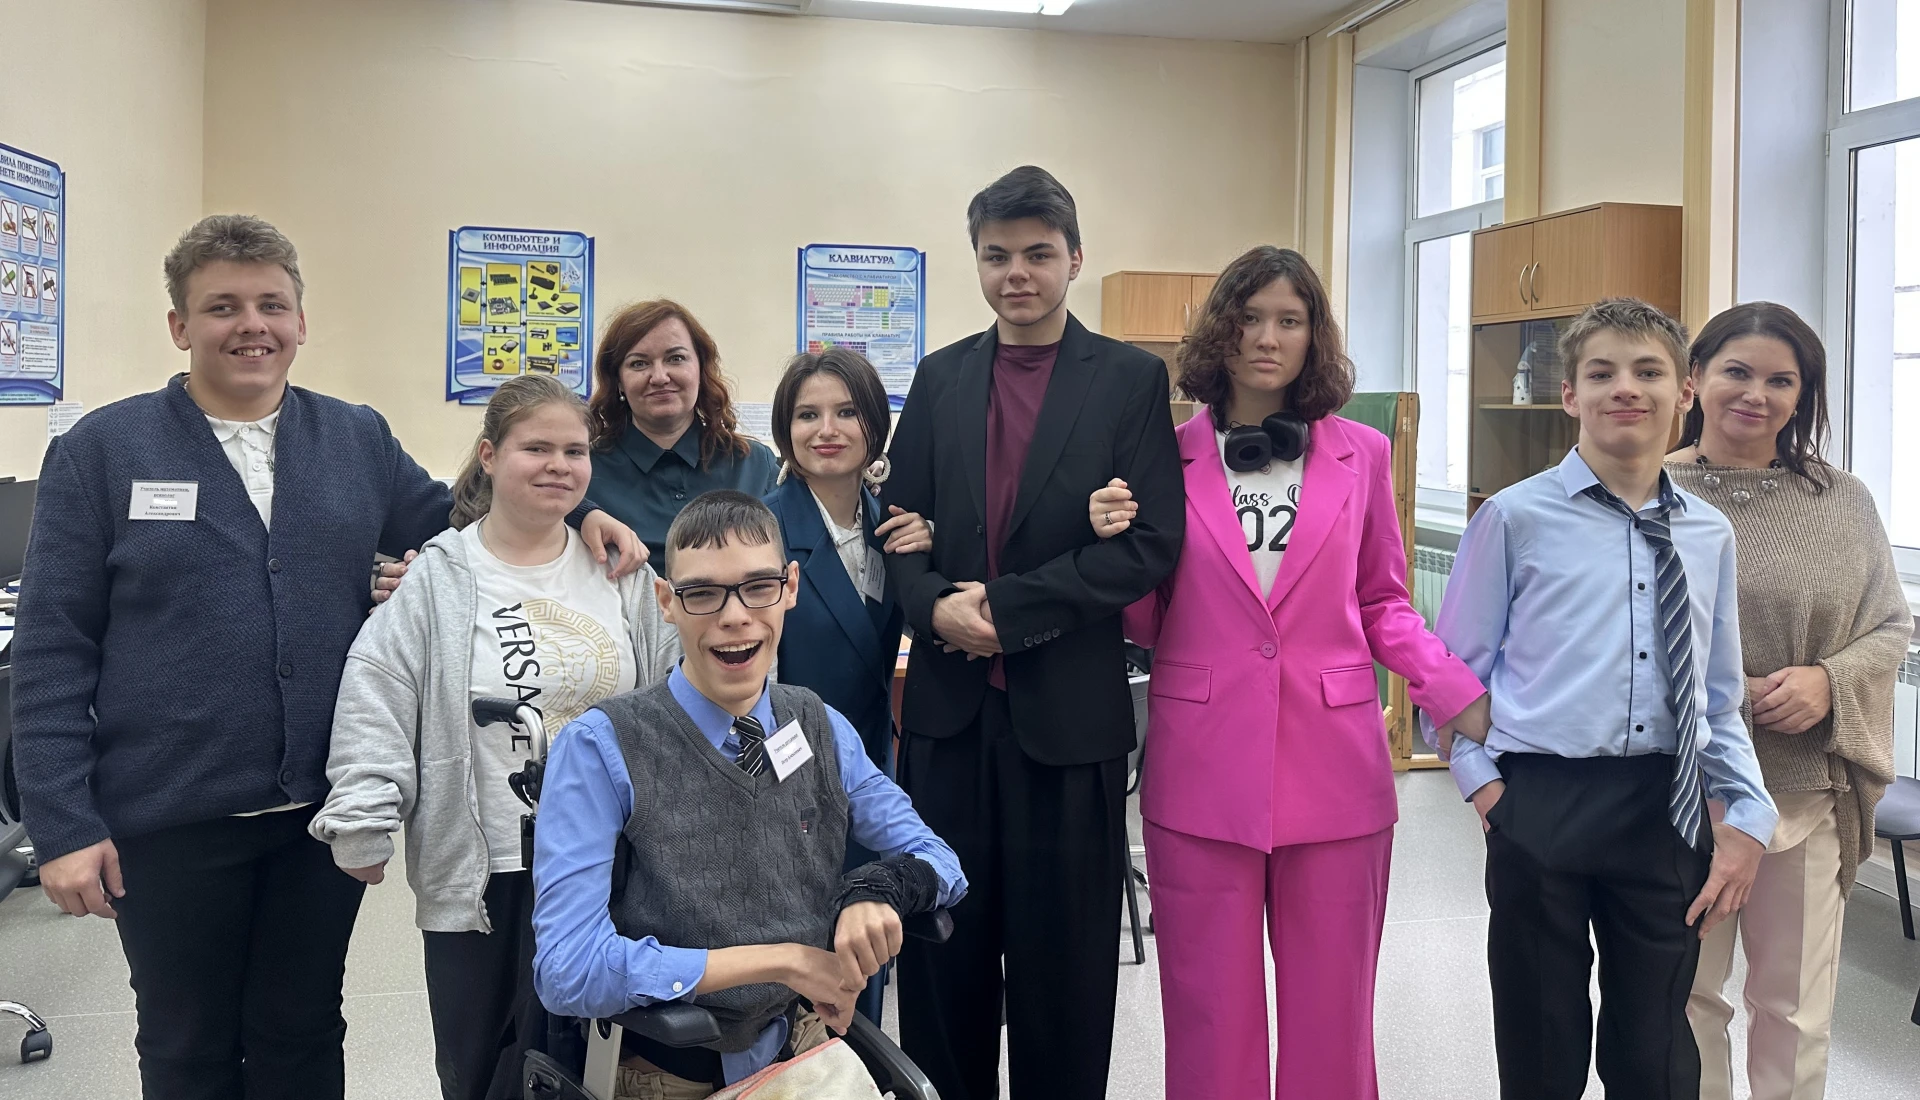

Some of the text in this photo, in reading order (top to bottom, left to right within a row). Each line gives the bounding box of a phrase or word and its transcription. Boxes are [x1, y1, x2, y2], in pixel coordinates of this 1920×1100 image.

[0, 154, 51, 179] ВИЛА ПОВЕДЕНИЯ
[16, 171, 59, 193] ИНФОРМАТИКИ
[482, 233, 561, 245] КОМПЬЮТЕР И
[483, 242, 560, 254] ИНФОРМАЦИЯ
[829, 254, 896, 265] КЛАВИАТУРА
[1229, 485, 1273, 507] lass
[492, 602, 543, 752] VERSAE
